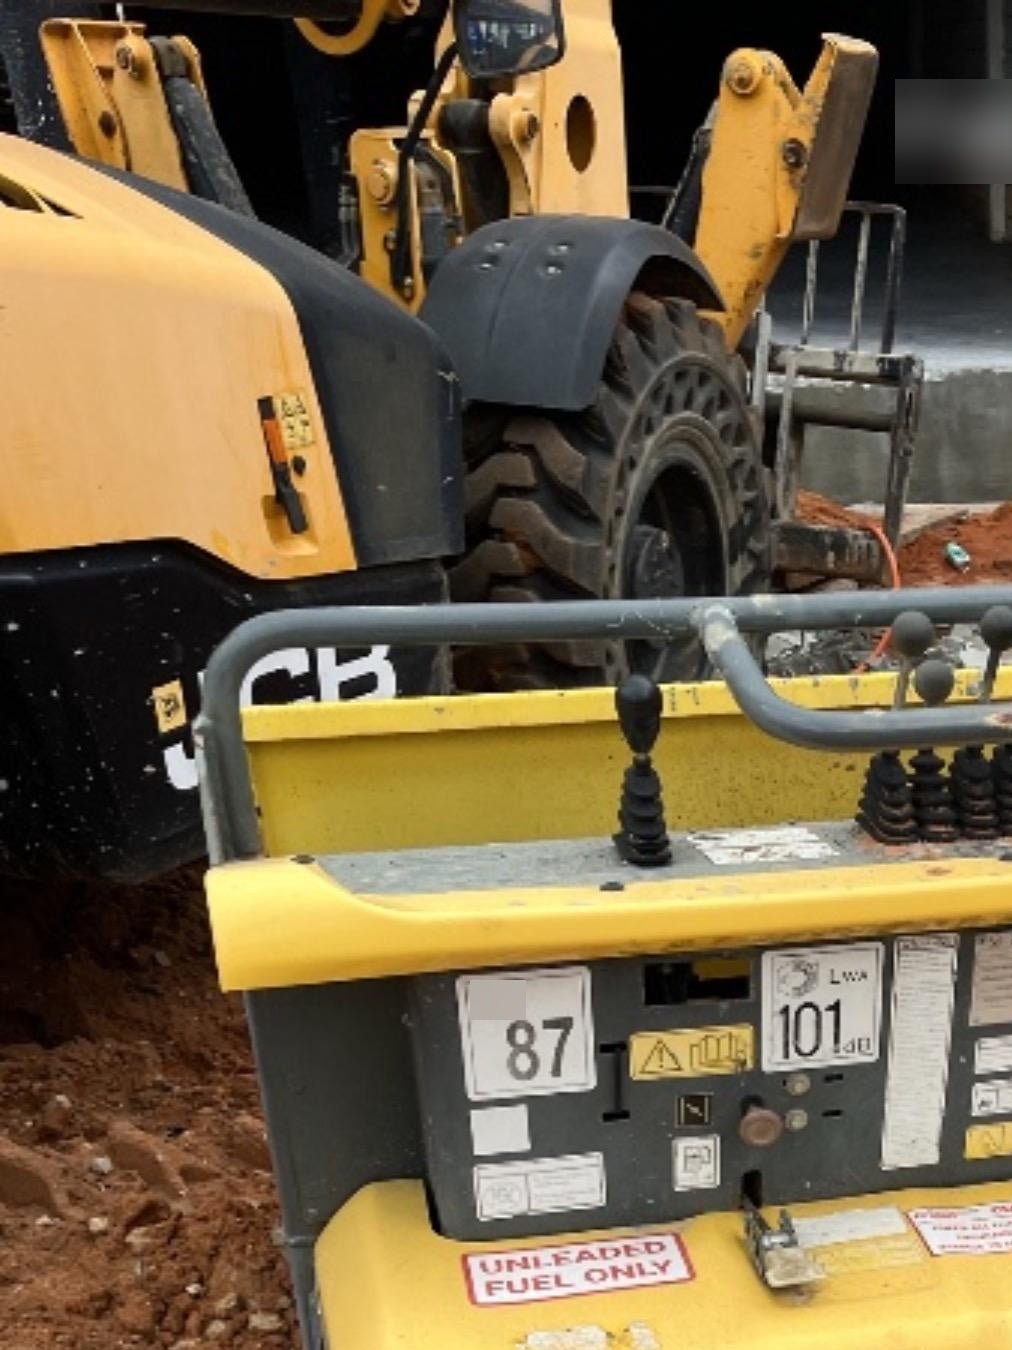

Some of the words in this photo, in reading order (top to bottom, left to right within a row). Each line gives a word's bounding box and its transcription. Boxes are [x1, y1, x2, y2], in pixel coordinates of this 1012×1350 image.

[506, 1016, 573, 1081] 87
[779, 999, 841, 1060] 101
[479, 1240, 667, 1274] UNLEADED
[485, 1273, 573, 1297] FUEL
[584, 1258, 672, 1284] ONLY
